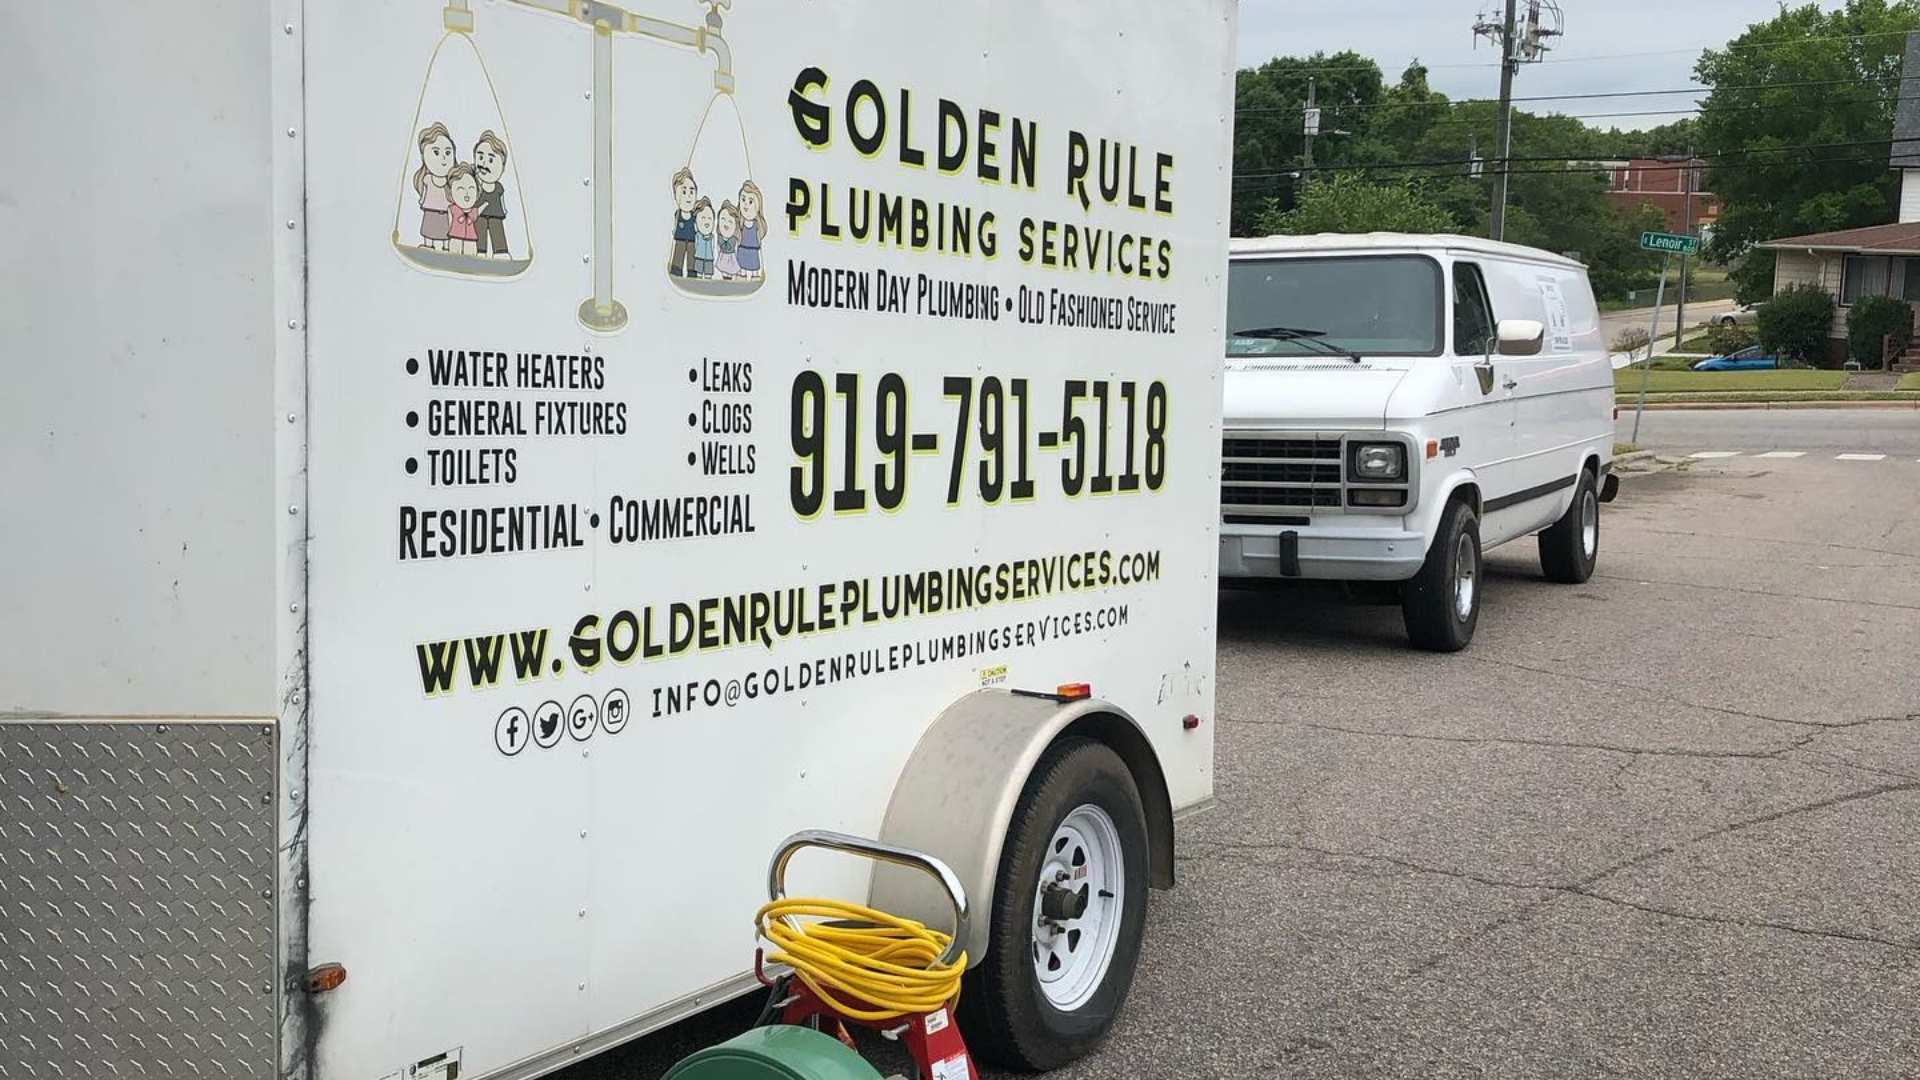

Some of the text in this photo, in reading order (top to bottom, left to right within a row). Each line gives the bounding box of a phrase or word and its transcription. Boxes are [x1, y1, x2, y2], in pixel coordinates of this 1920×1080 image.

[787, 66, 1173, 214] GOLDEN RULE
[786, 177, 1171, 279] PLUMBING SERVICES
[1649, 234, 1683, 249] Lenoir
[787, 259, 1176, 334] MODERN DAY PLUMBING OLD FASHIONED SERVICE
[427, 349, 605, 390] WATER HEATERS
[703, 357, 752, 393] LEAKS
[428, 399, 627, 437] GENERAL FIXTURES
[702, 399, 752, 434] CLOGS
[790, 369, 1167, 517] 919-791-5118
[427, 448, 517, 486] TOILETS
[702, 441, 756, 476] WELLS
[399, 494, 756, 561] RESIDENTIAL COMMERCIAL
[415, 550, 1161, 694] WWW.GOLDENRULEPLUMBINGSERVICES.COM
[652, 604, 1129, 718] INFO@GOLDENRULEPLUMBINGSERVICES.COM
